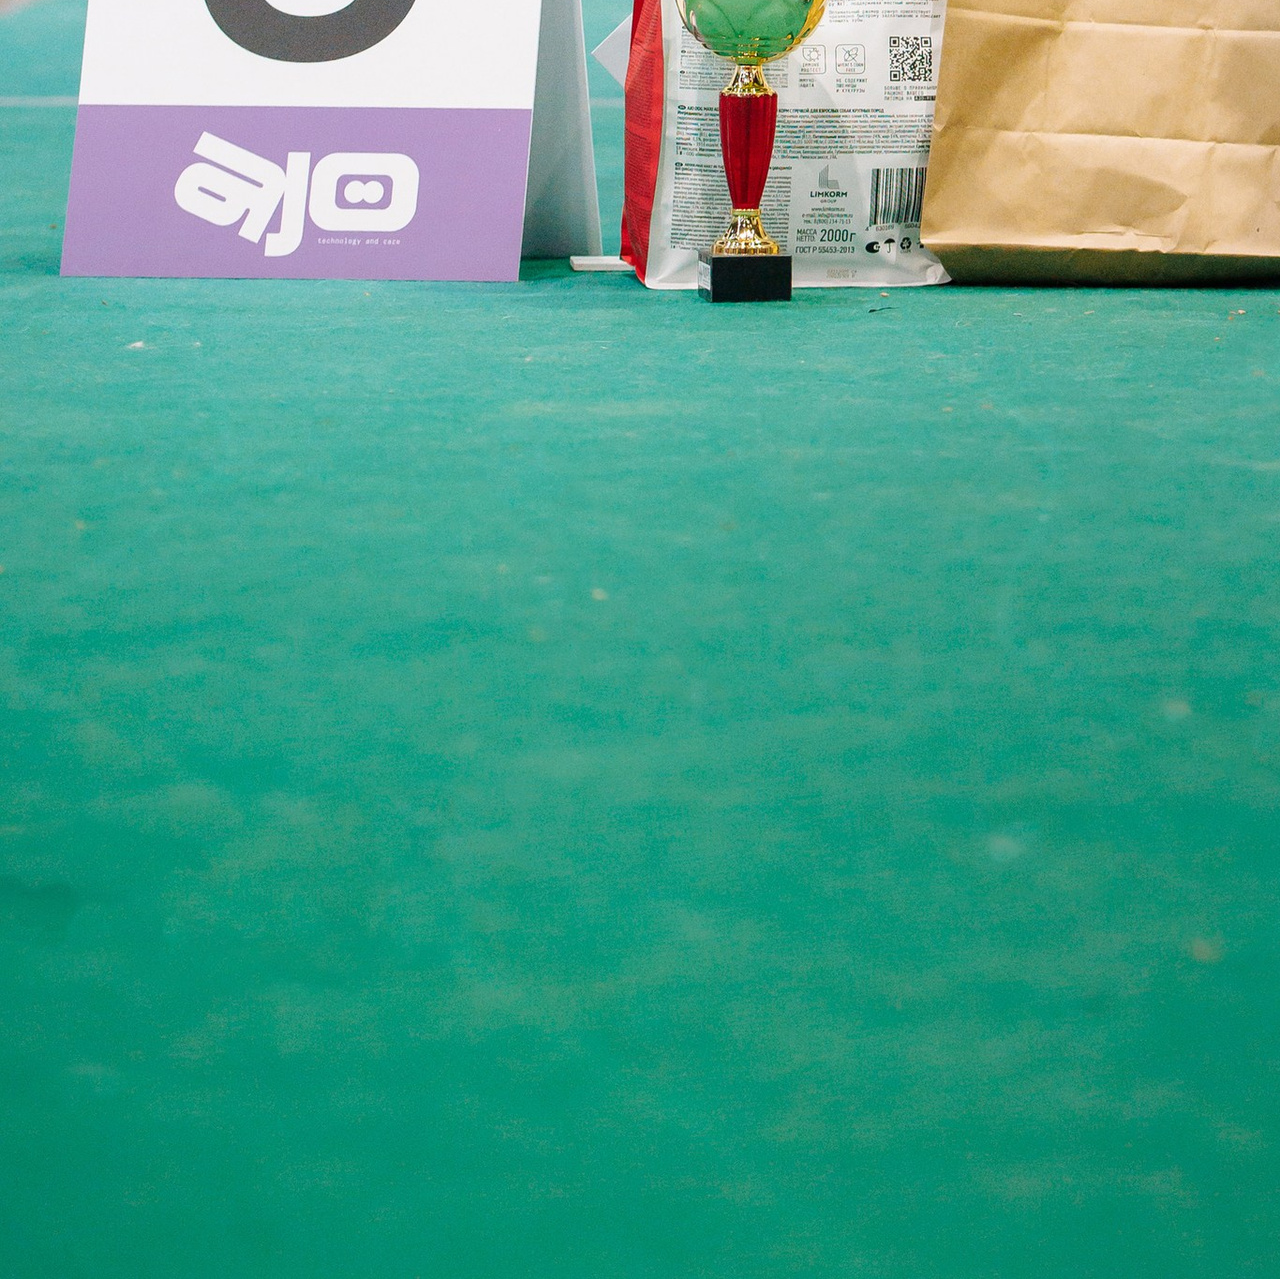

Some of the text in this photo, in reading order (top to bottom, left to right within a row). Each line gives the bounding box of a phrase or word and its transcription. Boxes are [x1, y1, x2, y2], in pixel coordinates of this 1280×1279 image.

[810, 190, 848, 198] LIMKORM
[317, 237, 401, 246] technology and care
[795, 246, 811, 254] ГОСТ
